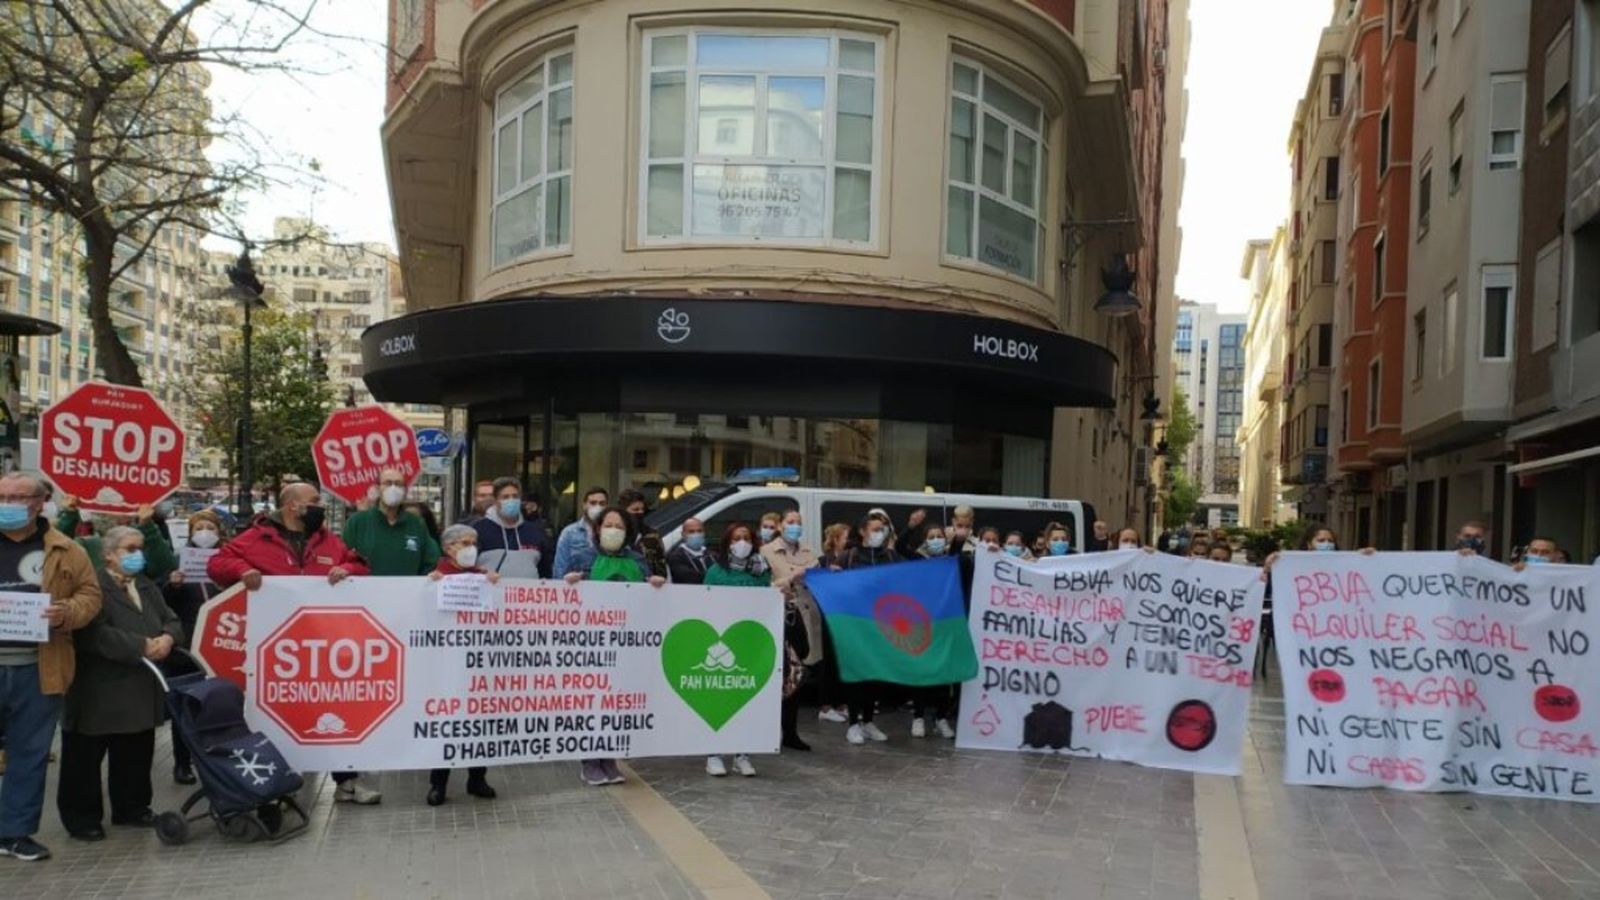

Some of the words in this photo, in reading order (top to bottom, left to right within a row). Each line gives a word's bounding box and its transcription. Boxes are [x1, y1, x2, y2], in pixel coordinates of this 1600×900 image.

[718, 187, 801, 202] OFICINAS
[973, 335, 1039, 362] HOLBOX
[52, 412, 176, 464] STOP
[322, 429, 409, 472] STOP
[52, 455, 171, 487] DESAHUCIOS
[993, 560, 1033, 588] EL
[1054, 570, 1114, 594] BBVA
[1123, 571, 1162, 594] NOS
[1293, 571, 1376, 611] BBVA
[1382, 573, 1531, 607] QUEREMOS
[1551, 585, 1587, 614] UN
[562, 588, 583, 607] YA,
[456, 611, 473, 624] NI
[479, 608, 499, 625] UN
[504, 608, 581, 625] DESAHUCIO
[1138, 598, 1226, 639] SOMOS
[527, 629, 548, 647] UN
[552, 629, 606, 647] PARQUE
[1103, 622, 1119, 644] Y
[1128, 621, 1243, 665] TENEMOS
[1548, 629, 1590, 656] NO
[273, 638, 390, 679] STOP
[466, 651, 484, 669] DE
[487, 650, 552, 669] VIVIENDA
[556, 650, 617, 668] SOCIAL!!!
[982, 637, 1109, 668] DERECHO
[1126, 646, 1138, 669] A
[1144, 650, 1178, 675] UN
[1299, 646, 1355, 669] NOS
[1370, 647, 1515, 681] NEGAMOS
[1526, 658, 1556, 685] A
[267, 680, 395, 704] DESNONAMENTS
[468, 675, 489, 693] JA
[494, 674, 528, 692] N'HI
[533, 673, 557, 690] HA
[562, 673, 612, 692] PROU,
[680, 675, 702, 689] PAH
[705, 675, 756, 689] VALENCIA
[982, 665, 1061, 697] DIGNO
[1373, 676, 1487, 712] PAGAR
[425, 697, 461, 716] CAP
[466, 693, 595, 715] DESNONAMENT
[413, 717, 519, 739] NECESSITEM
[524, 716, 549, 734] UN
[554, 714, 595, 733] PARC
[1340, 714, 1444, 741] GENTE
[1516, 727, 1600, 758] CASA
[443, 737, 551, 761] D'HABITATGE
[556, 734, 631, 754] SOCIAL!!!
[1490, 763, 1594, 796] GENTE
